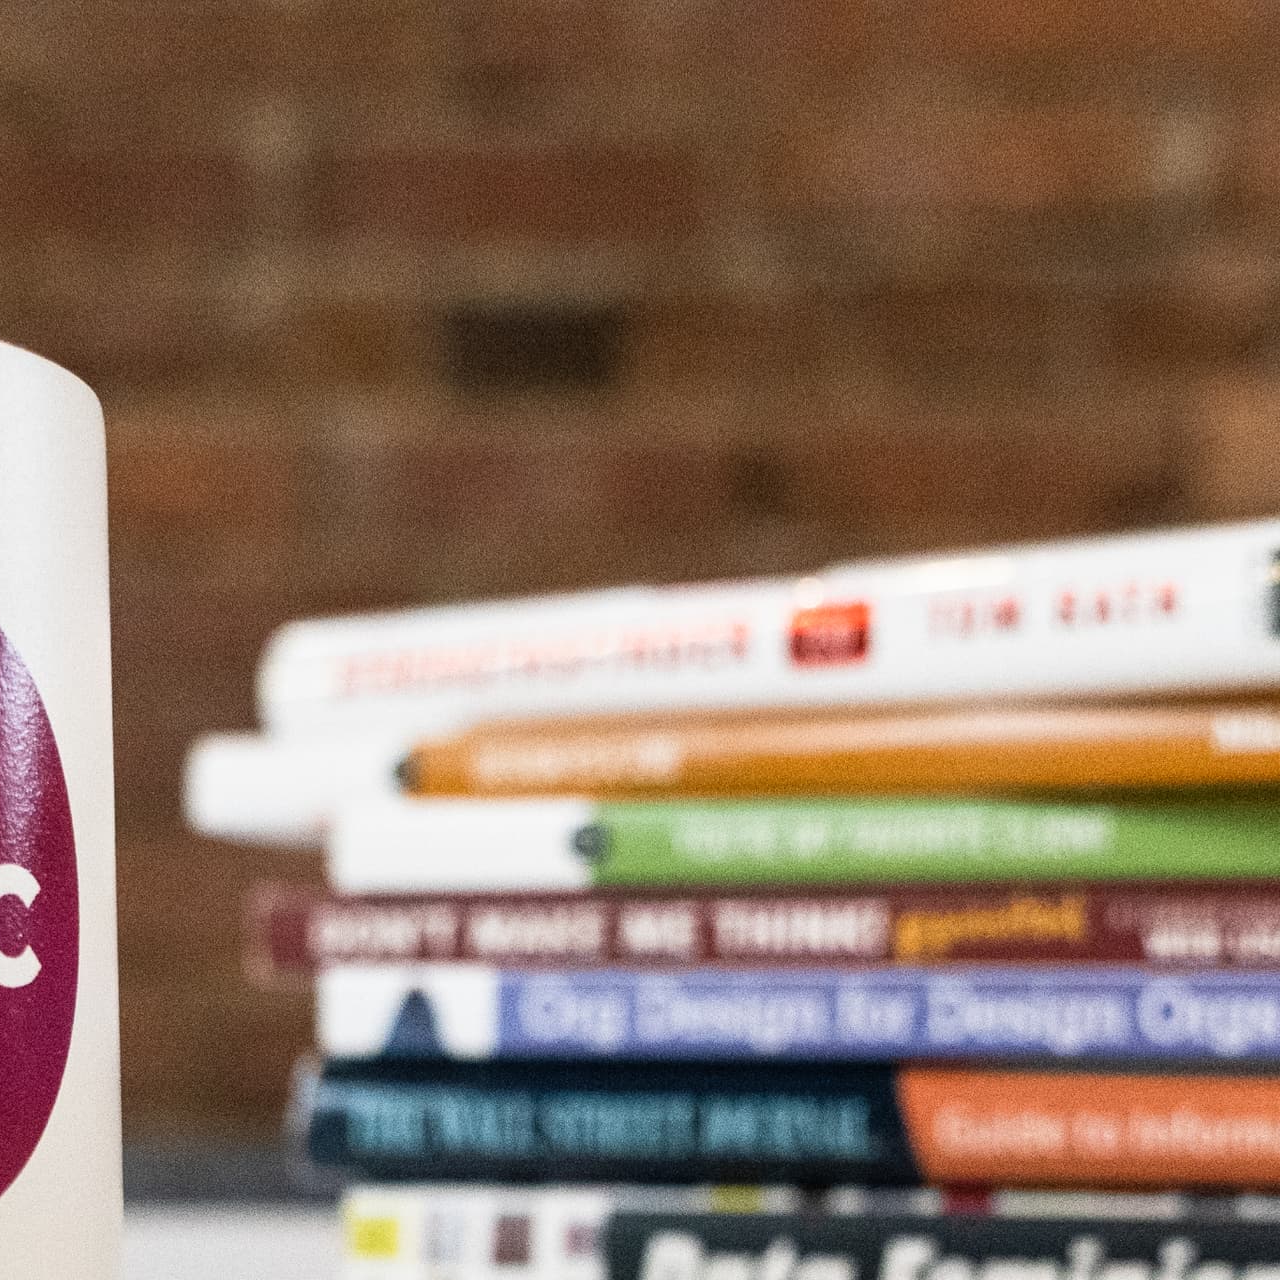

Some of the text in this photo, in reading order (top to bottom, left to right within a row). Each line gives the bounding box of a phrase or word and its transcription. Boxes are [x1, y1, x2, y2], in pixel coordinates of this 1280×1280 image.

[926, 592, 1022, 638] TOM
[308, 901, 459, 958] DON'T
[617, 902, 700, 957] ME
[517, 981, 629, 1054] Org
[635, 979, 827, 1052] Design
[832, 980, 916, 1039] for
[925, 979, 1130, 1054] Design
[931, 1104, 1067, 1155] Guide
[1072, 1108, 1118, 1155] to
